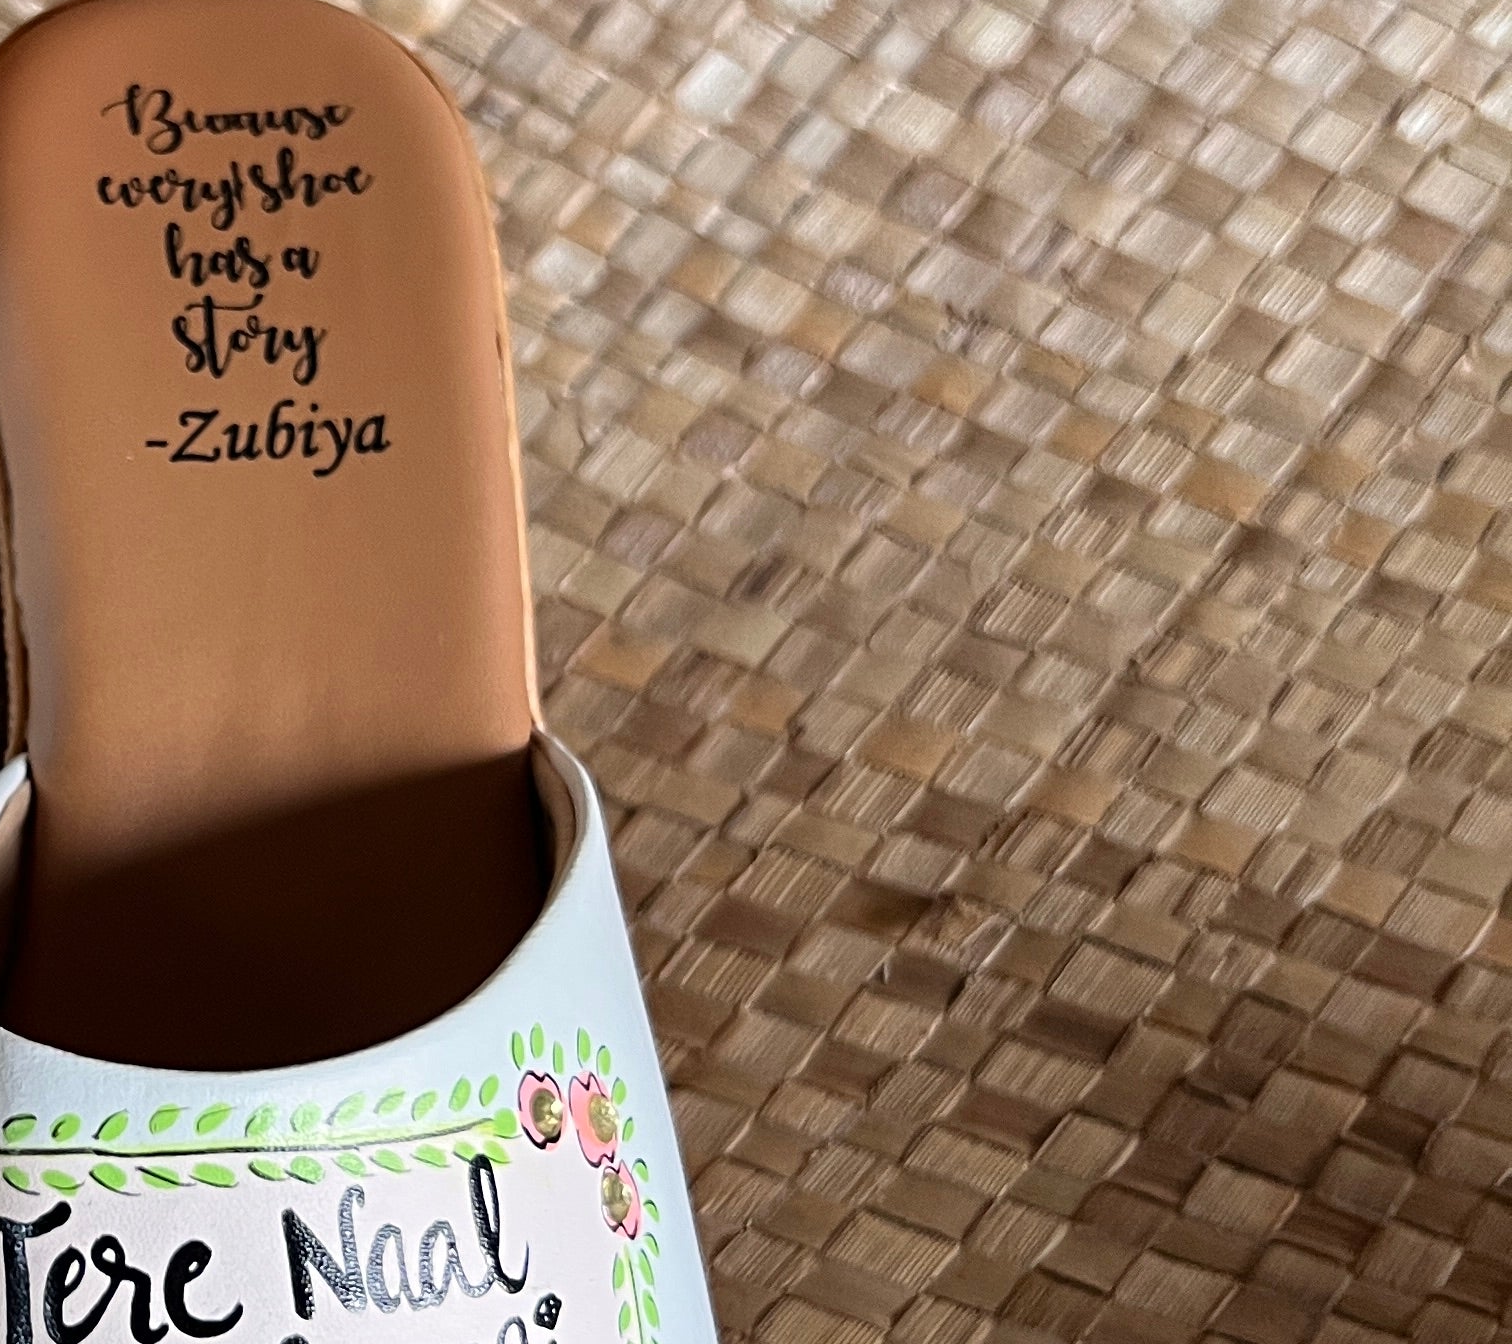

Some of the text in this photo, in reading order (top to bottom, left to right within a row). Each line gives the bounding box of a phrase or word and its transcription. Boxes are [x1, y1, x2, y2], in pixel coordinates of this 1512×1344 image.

[164, 222, 320, 289] has a
[172, 293, 328, 386] story
[282, 1154, 530, 1320] Naal
